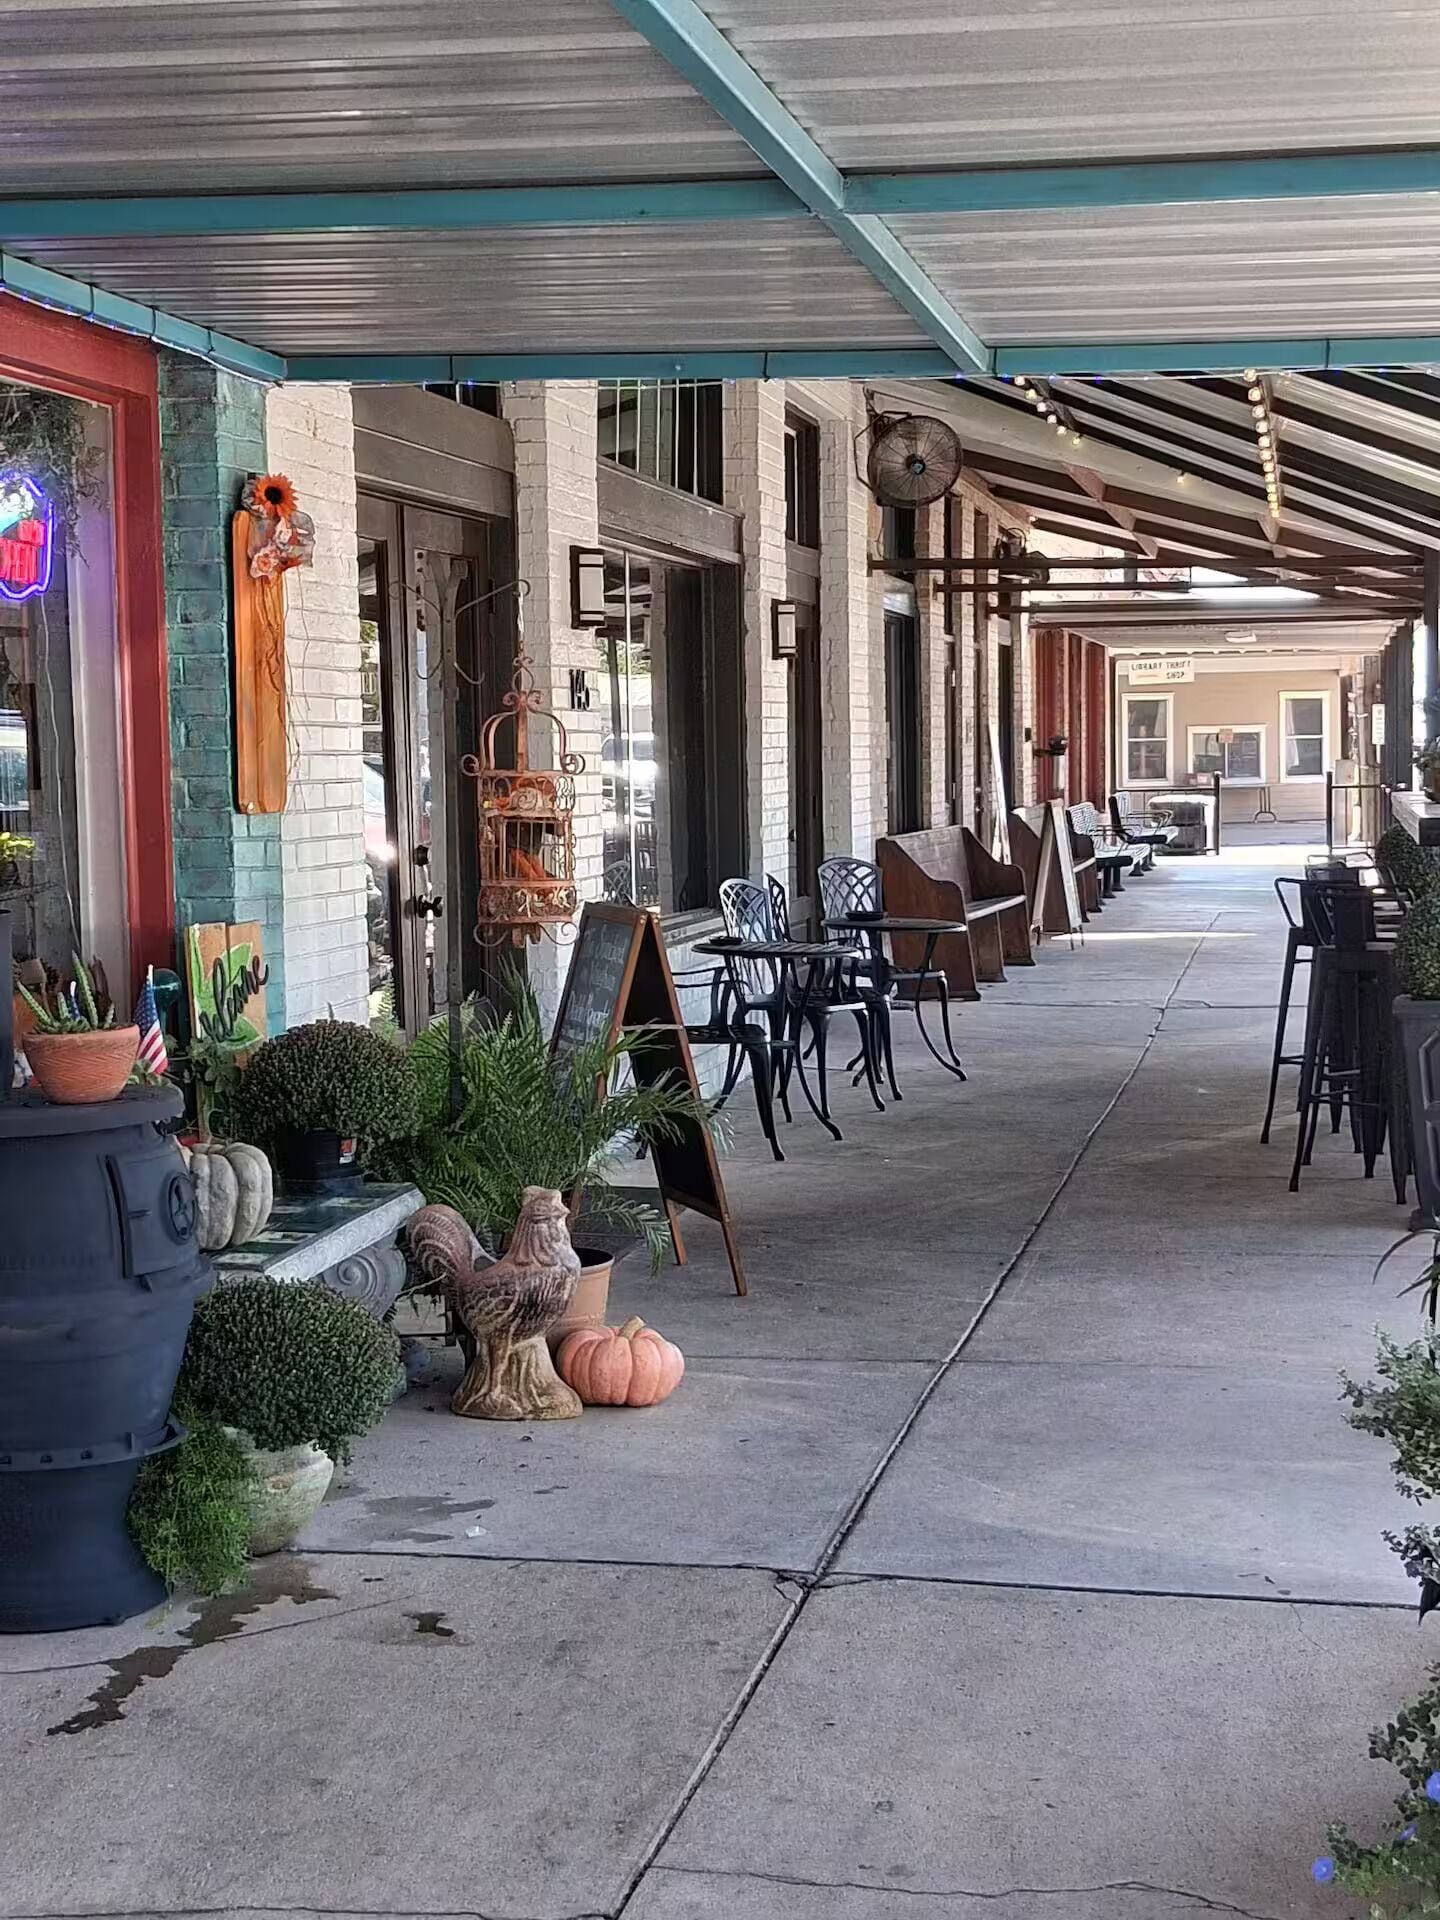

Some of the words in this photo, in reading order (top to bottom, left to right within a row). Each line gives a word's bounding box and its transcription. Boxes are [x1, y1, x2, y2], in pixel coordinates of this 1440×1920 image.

[1131, 662, 1162, 671] LIBRARY
[1166, 660, 1191, 668] THRIFT
[1166, 671, 1185, 679] SHOP
